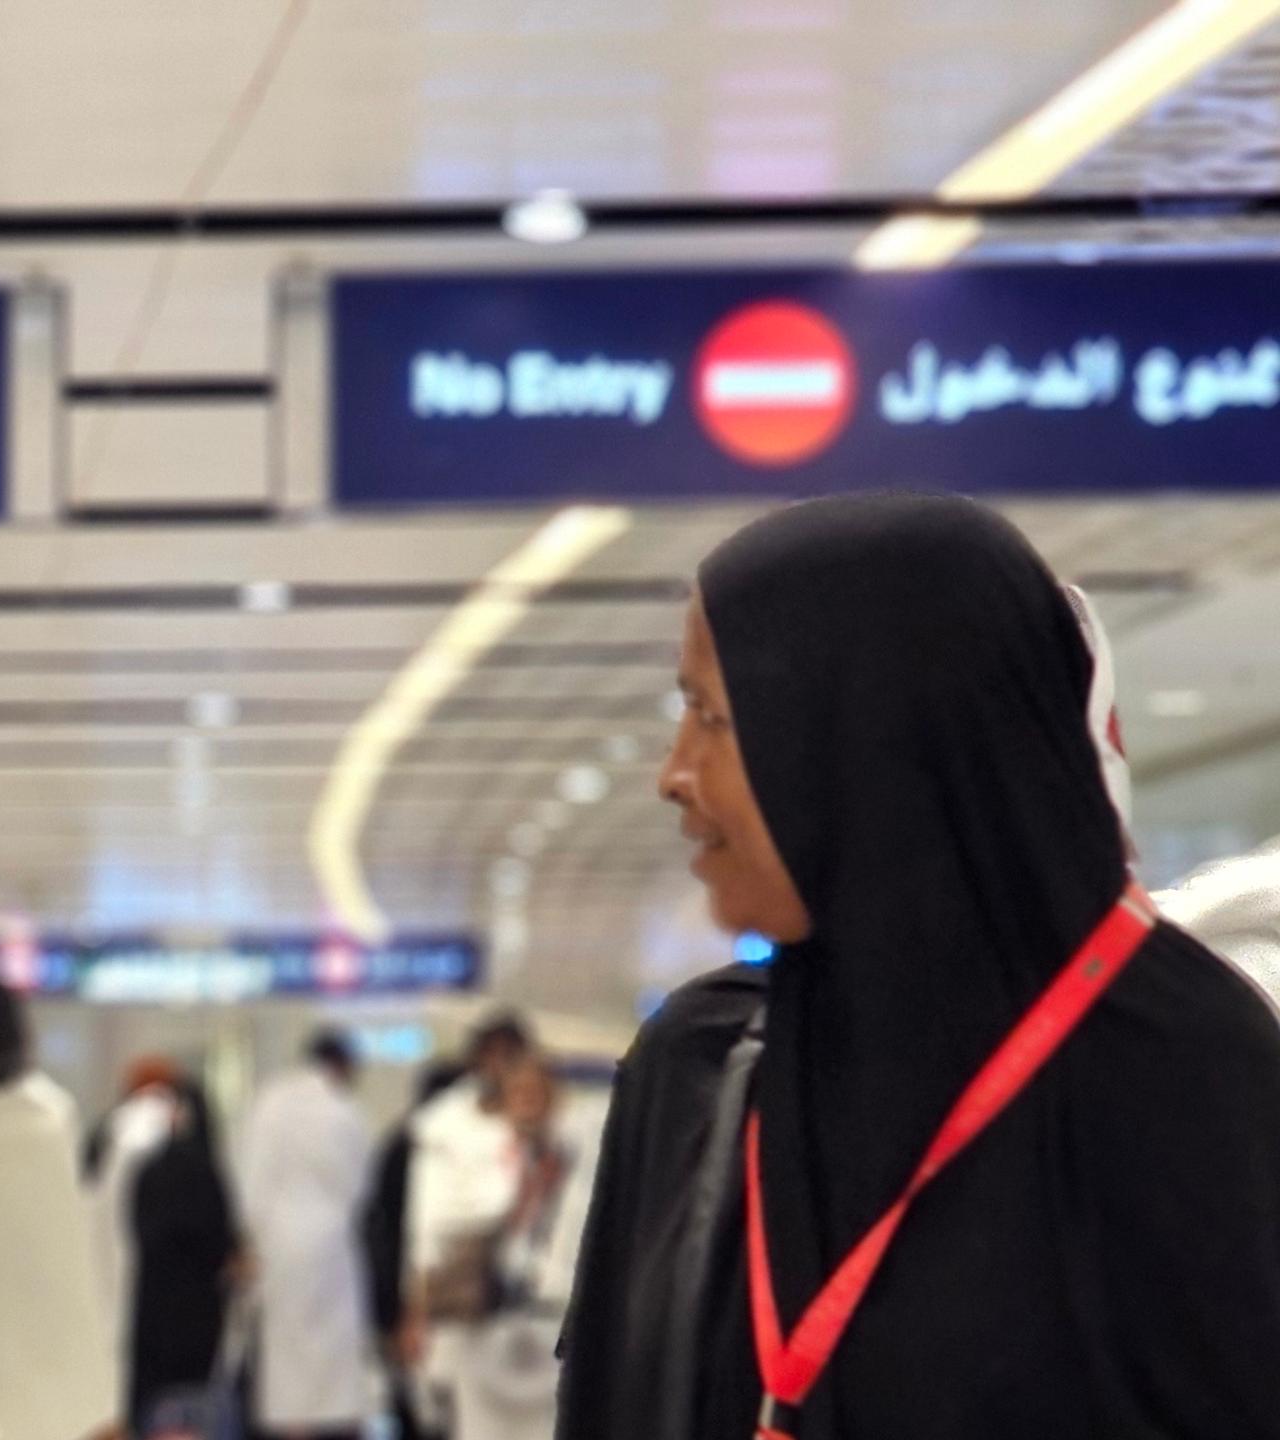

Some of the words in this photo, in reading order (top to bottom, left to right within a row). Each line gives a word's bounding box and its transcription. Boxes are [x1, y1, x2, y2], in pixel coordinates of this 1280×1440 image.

[411, 351, 502, 417] No
[506, 351, 672, 424] Entry
[879, 336, 1121, 424] الدخول
